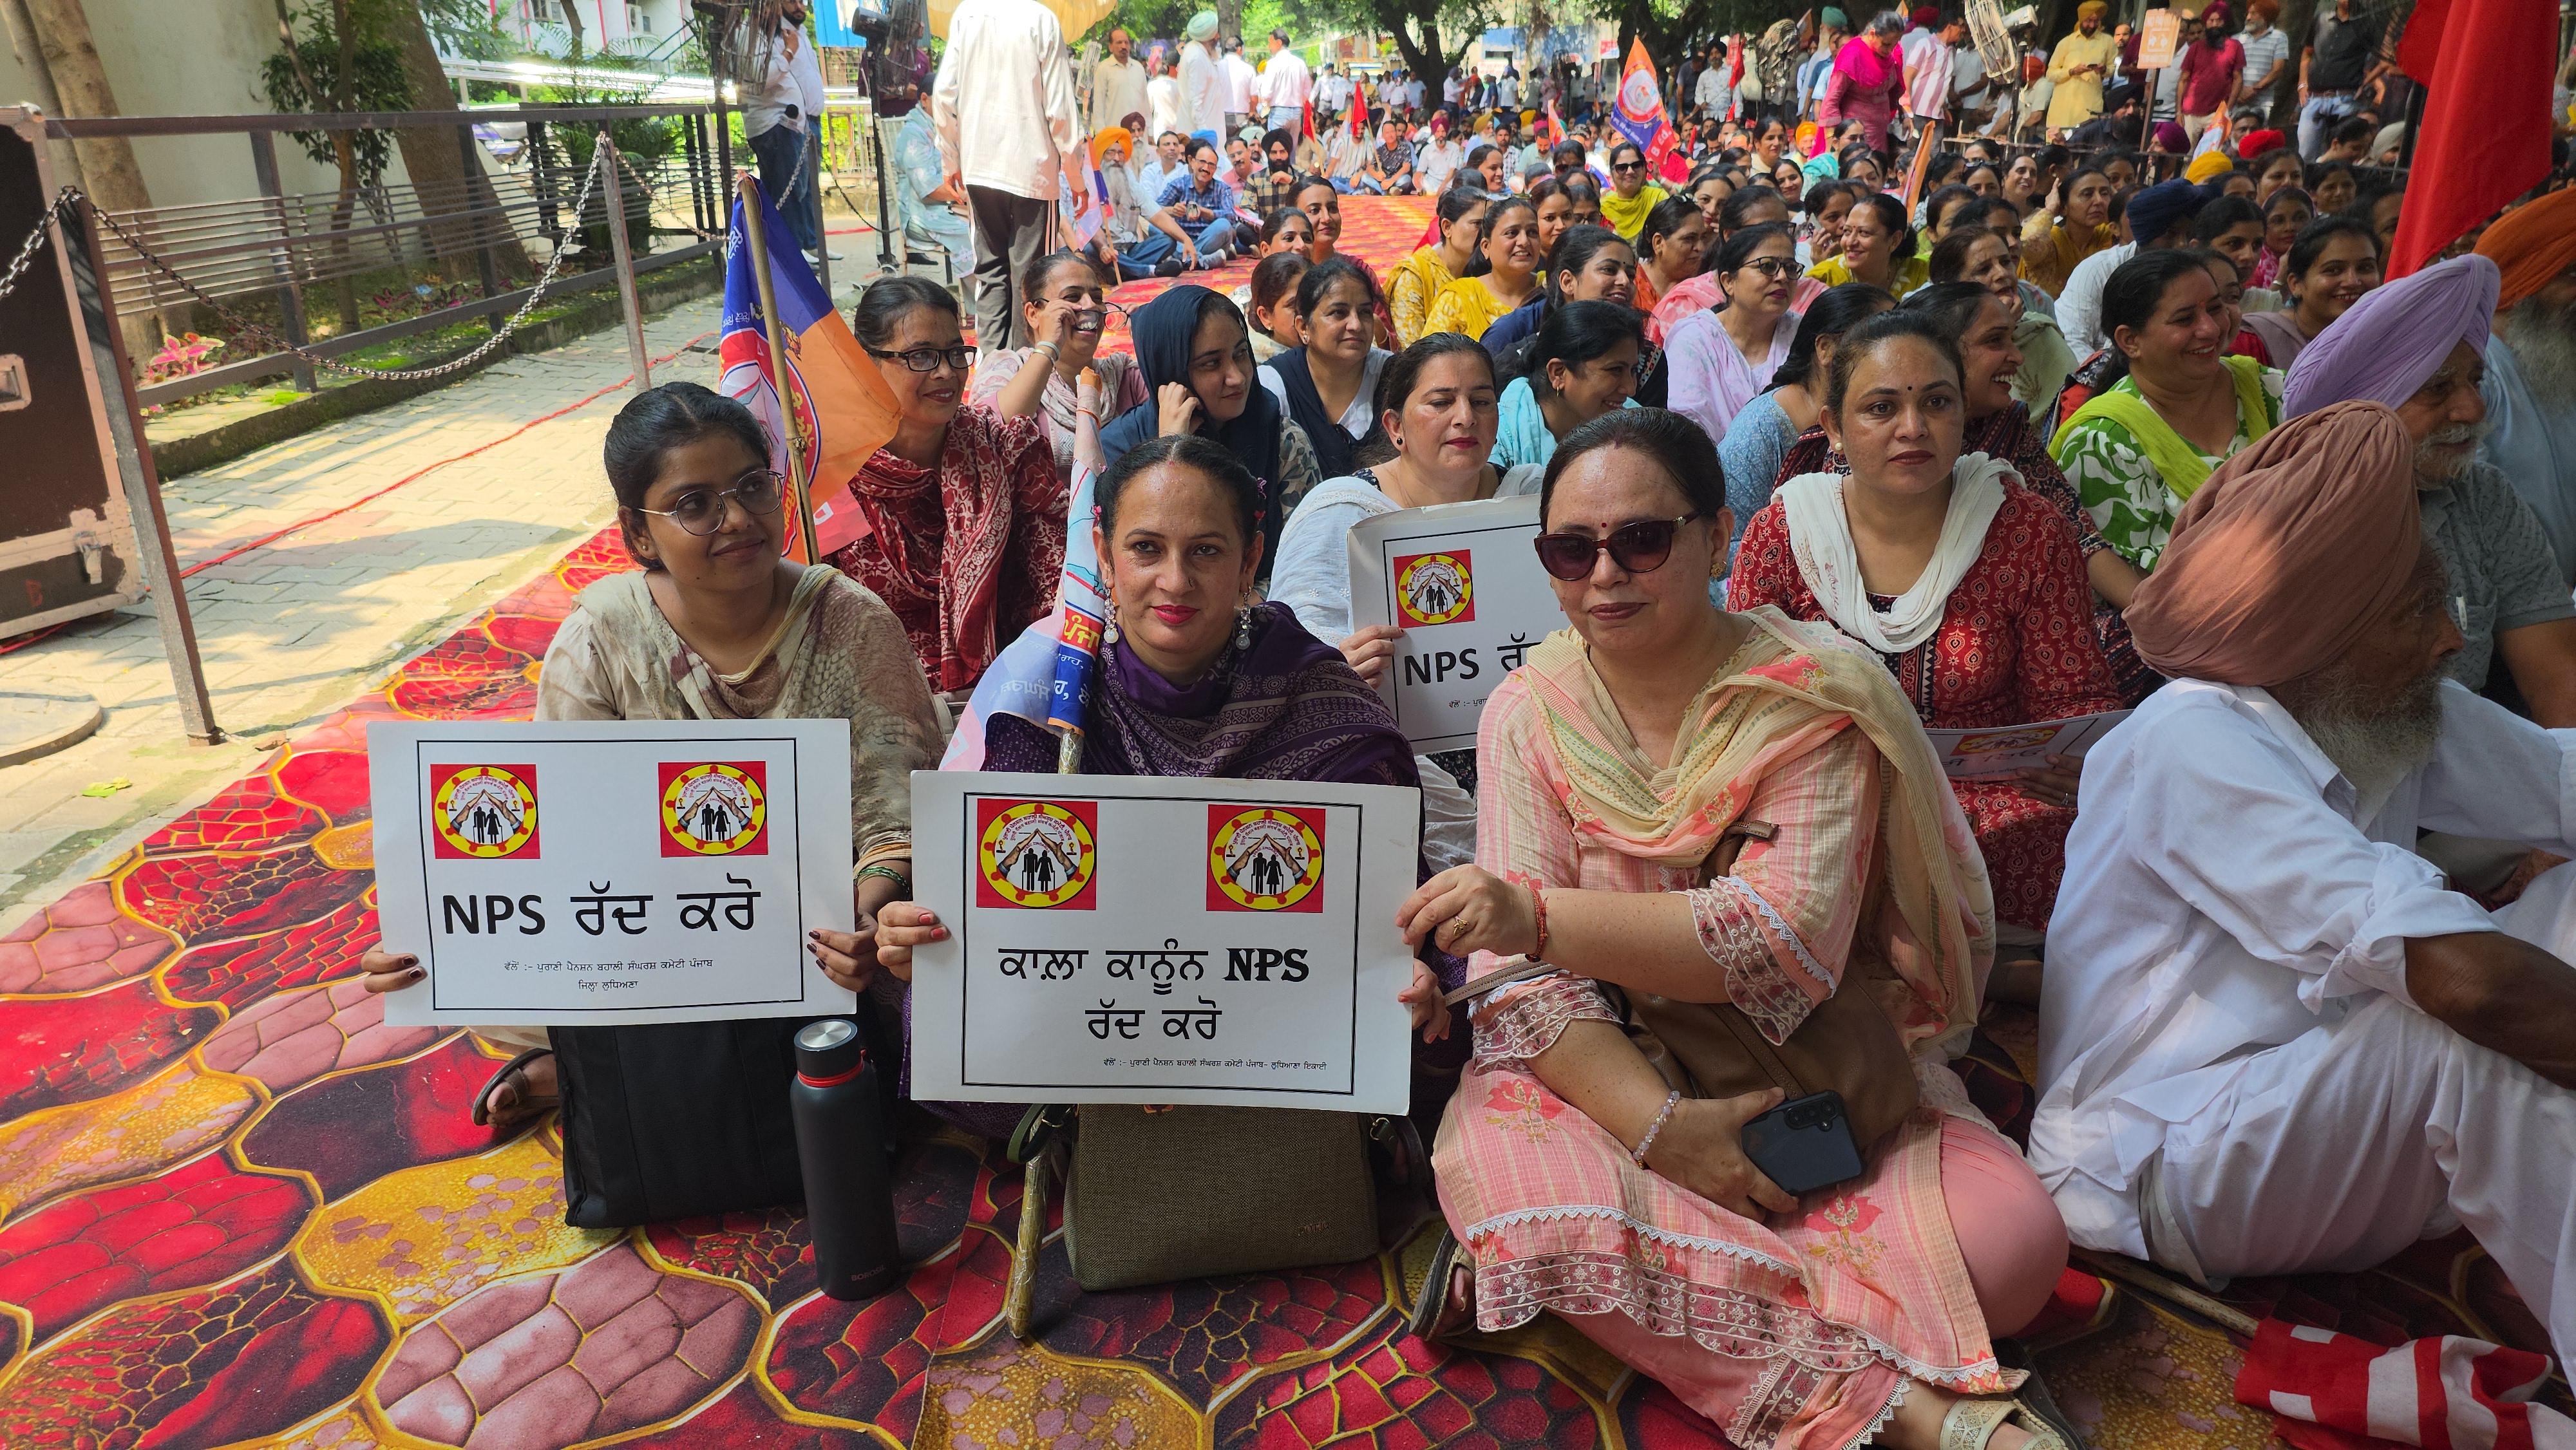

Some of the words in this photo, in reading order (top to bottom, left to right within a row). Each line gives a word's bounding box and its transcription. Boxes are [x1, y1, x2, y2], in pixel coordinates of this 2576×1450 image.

[1405, 648, 1479, 686] NPS
[442, 894, 545, 936] NPS
[570, 880, 654, 936] ਰੱਦ
[676, 872, 761, 932] ਕਰੋ
[536, 961, 563, 973] ਪੁਰਾਣੀ
[566, 961, 594, 972] ਪੈਨਸ਼ਨ
[596, 961, 624, 971] ਬਹਾਲੀ
[627, 960, 658, 970] ਸੰਘਰਸ਼
[660, 958, 686, 969] ਕਮੇਟੀ
[688, 957, 714, 968] ਪੰਜਾਬ
[1105, 937, 1209, 995] ਕਾਨੂੰਨ
[1222, 948, 1309, 983] NPS
[1084, 998, 1146, 1040] ਰੱਦ
[1161, 995, 1223, 1040] ਕਰੋ
[1130, 1057, 1151, 1068] ਪੁਰਾਣੀ
[1153, 1057, 1175, 1066] ਪੈਨਸ਼ਨ
[1176, 1058, 1197, 1067] ਬਹਾਲੀ
[1199, 1058, 1222, 1067] ਸੰਘਰਸ਼
[1224, 1059, 1244, 1068] ਕਮੇਟੀ
[1271, 1060, 1301, 1070] ਲੁਧਿਆਣਾ
[1303, 1060, 1327, 1071] ਇਕਾਈ
